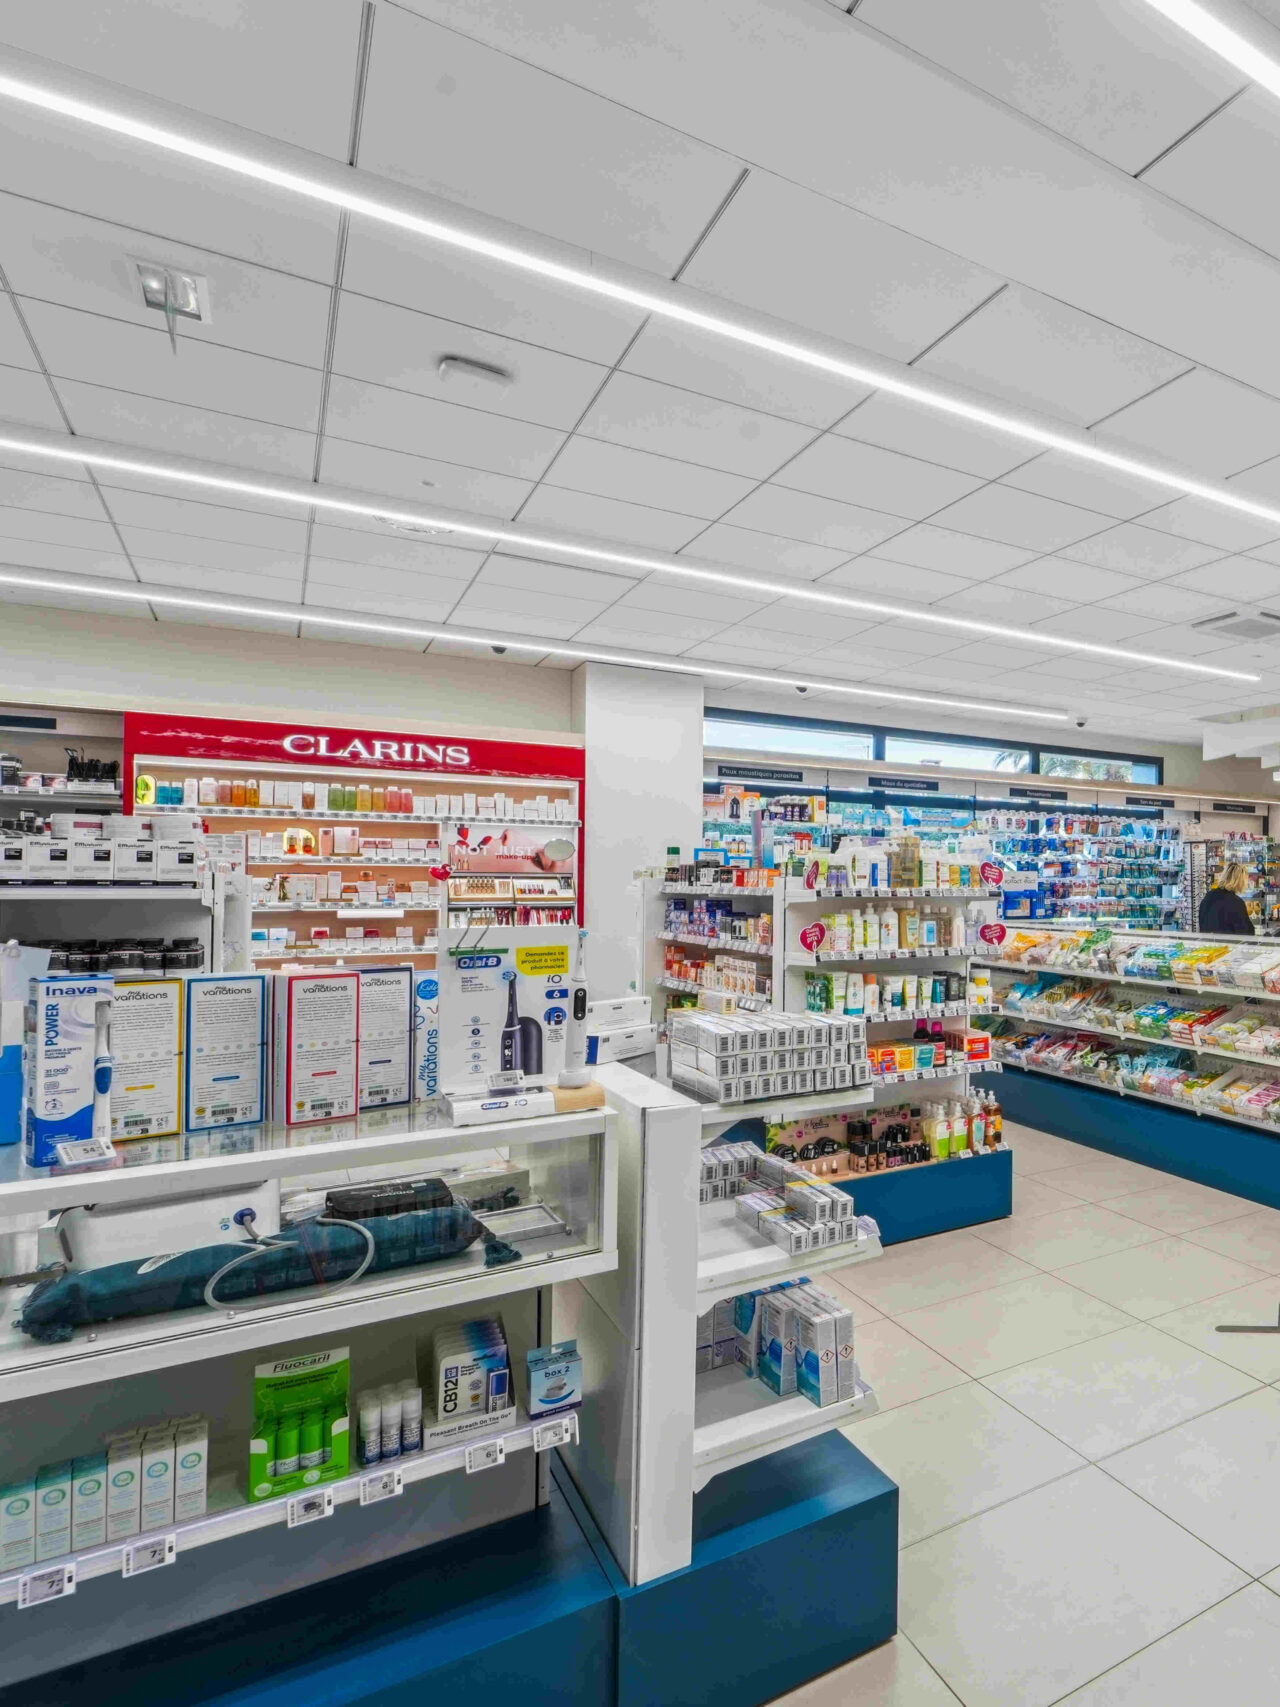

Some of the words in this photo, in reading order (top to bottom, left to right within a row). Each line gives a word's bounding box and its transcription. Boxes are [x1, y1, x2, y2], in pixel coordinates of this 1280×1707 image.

[283, 734, 471, 765] CLARINS
[454, 844, 490, 856] NOT
[494, 844, 536, 856] JUST
[460, 956, 498, 968] Oral-B
[360, 978, 402, 987] variations
[45, 985, 98, 996] Inava
[202, 986, 252, 996] variations
[302, 984, 348, 994] variations
[114, 991, 168, 1001] variations
[45, 1002, 59, 1047] POWER
[425, 1028, 438, 1097] variations
[273, 1353, 331, 1374] Fluocaril
[544, 1369, 562, 1378] box
[443, 1378, 459, 1414] CB12
[430, 1427, 457, 1438] Pleasant
[458, 1421, 479, 1431] Breath
